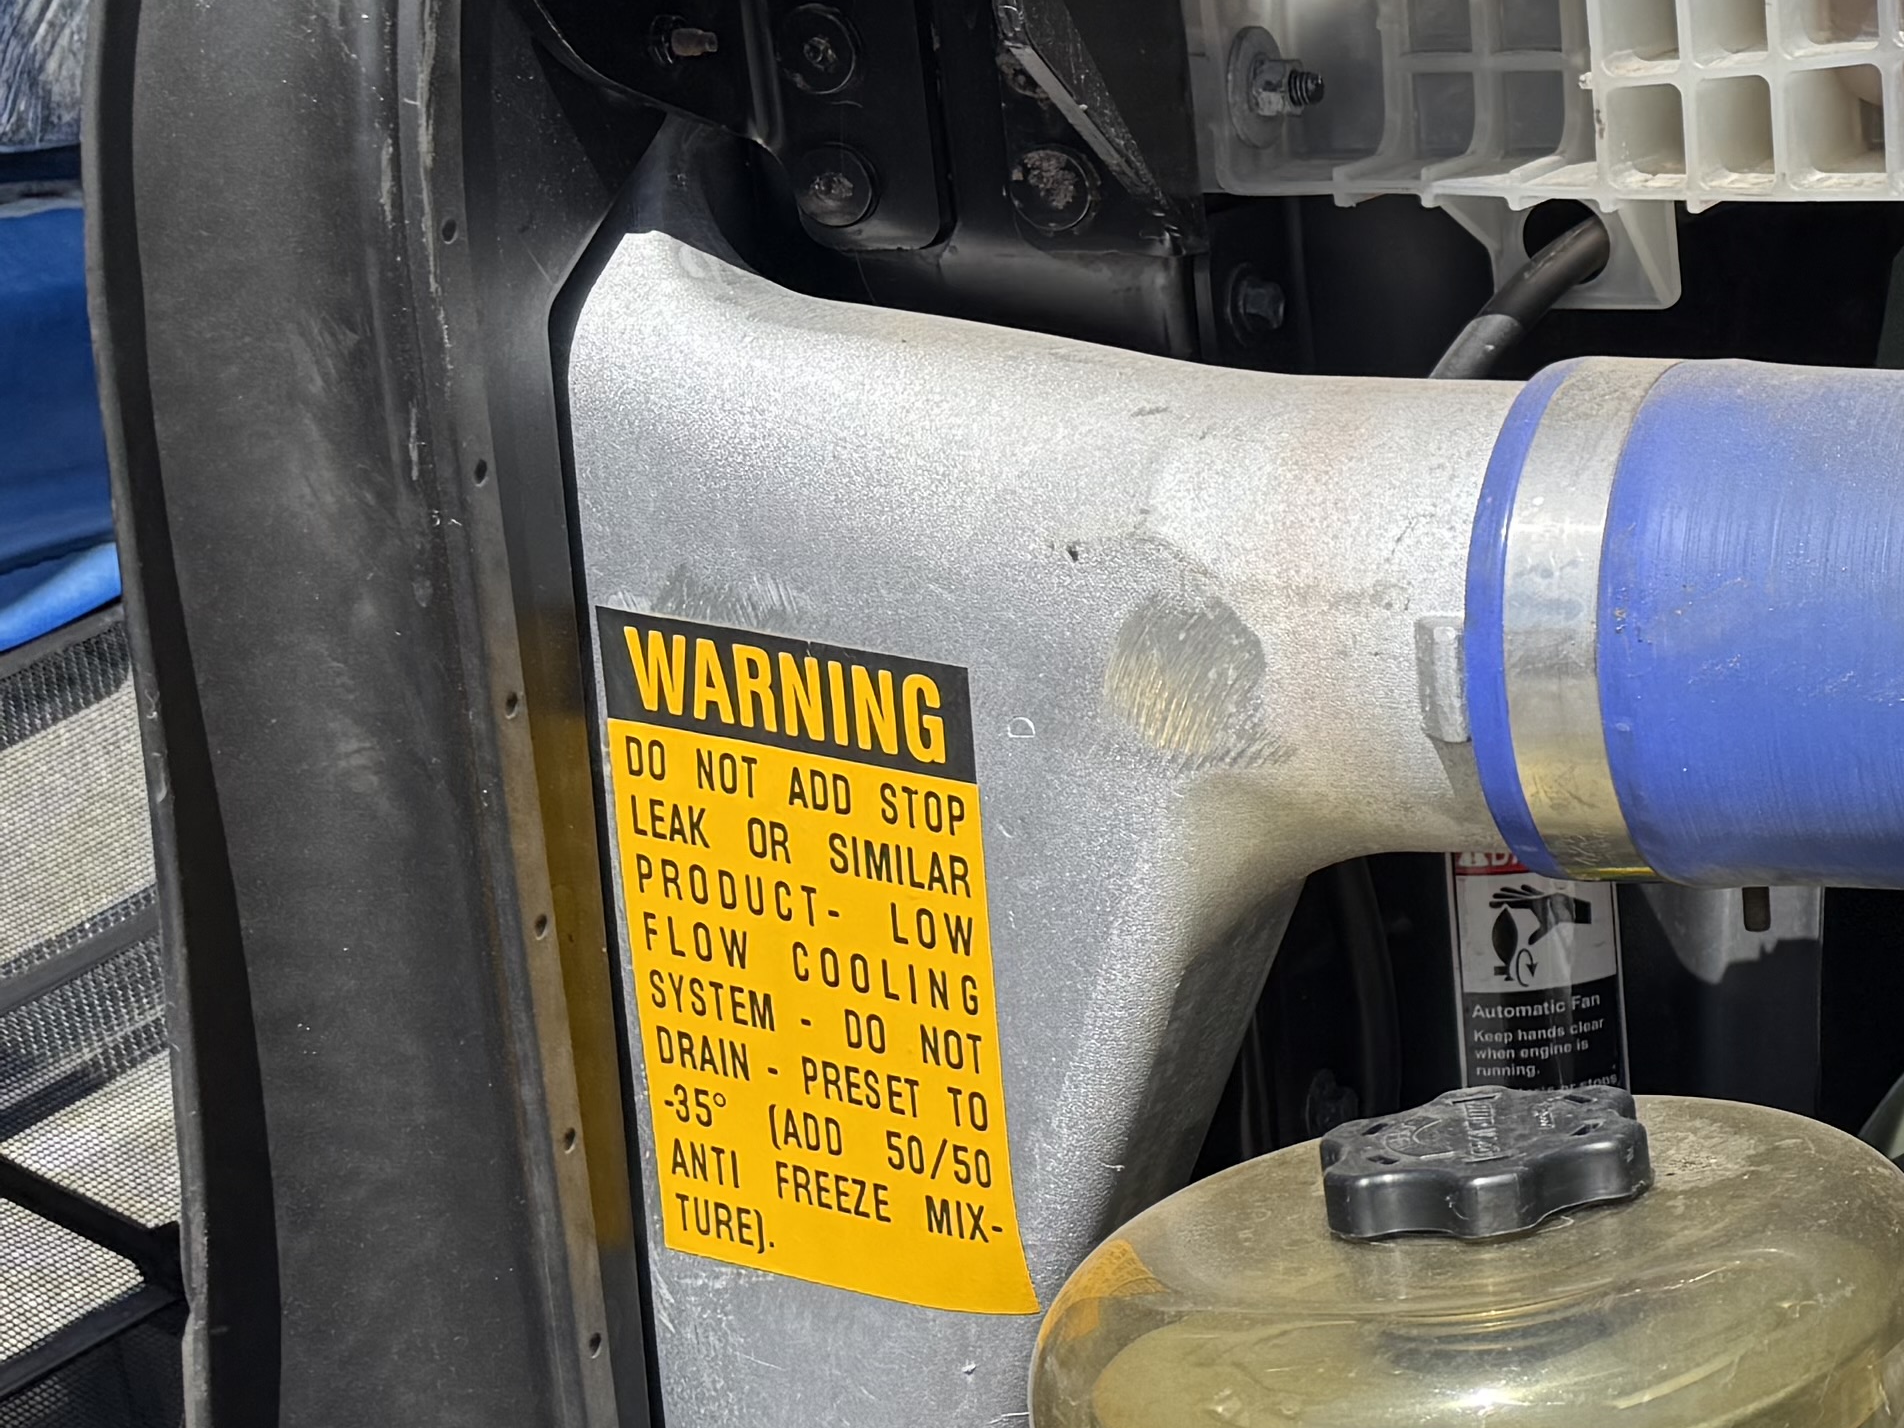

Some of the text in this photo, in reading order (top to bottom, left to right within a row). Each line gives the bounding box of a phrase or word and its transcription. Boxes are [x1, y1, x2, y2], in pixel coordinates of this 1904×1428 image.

[623, 626, 947, 764] WARNING
[625, 737, 964, 836] DO NOT ADD STOP
[631, 794, 971, 898] LEAK OR SIMILAR
[636, 855, 973, 956] PRODUCT- LOW
[644, 912, 979, 1016] FLOW COOLING
[1472, 994, 1600, 1018] Automatic Fan
[651, 969, 981, 1074] SYSTEM DO NOT
[1474, 1018, 1604, 1044] Keep hands clear
[1475, 1039, 1589, 1059] when engine is
[1476, 1064, 1541, 1078] running.
[656, 1026, 989, 1132] DRAIN PRESET TO
[664, 1084, 992, 1189] -35° (ADD 50/50
[671, 1138, 1004, 1243] ANTI FREEZE MIX-
[674, 1192, 775, 1254] TURE).
